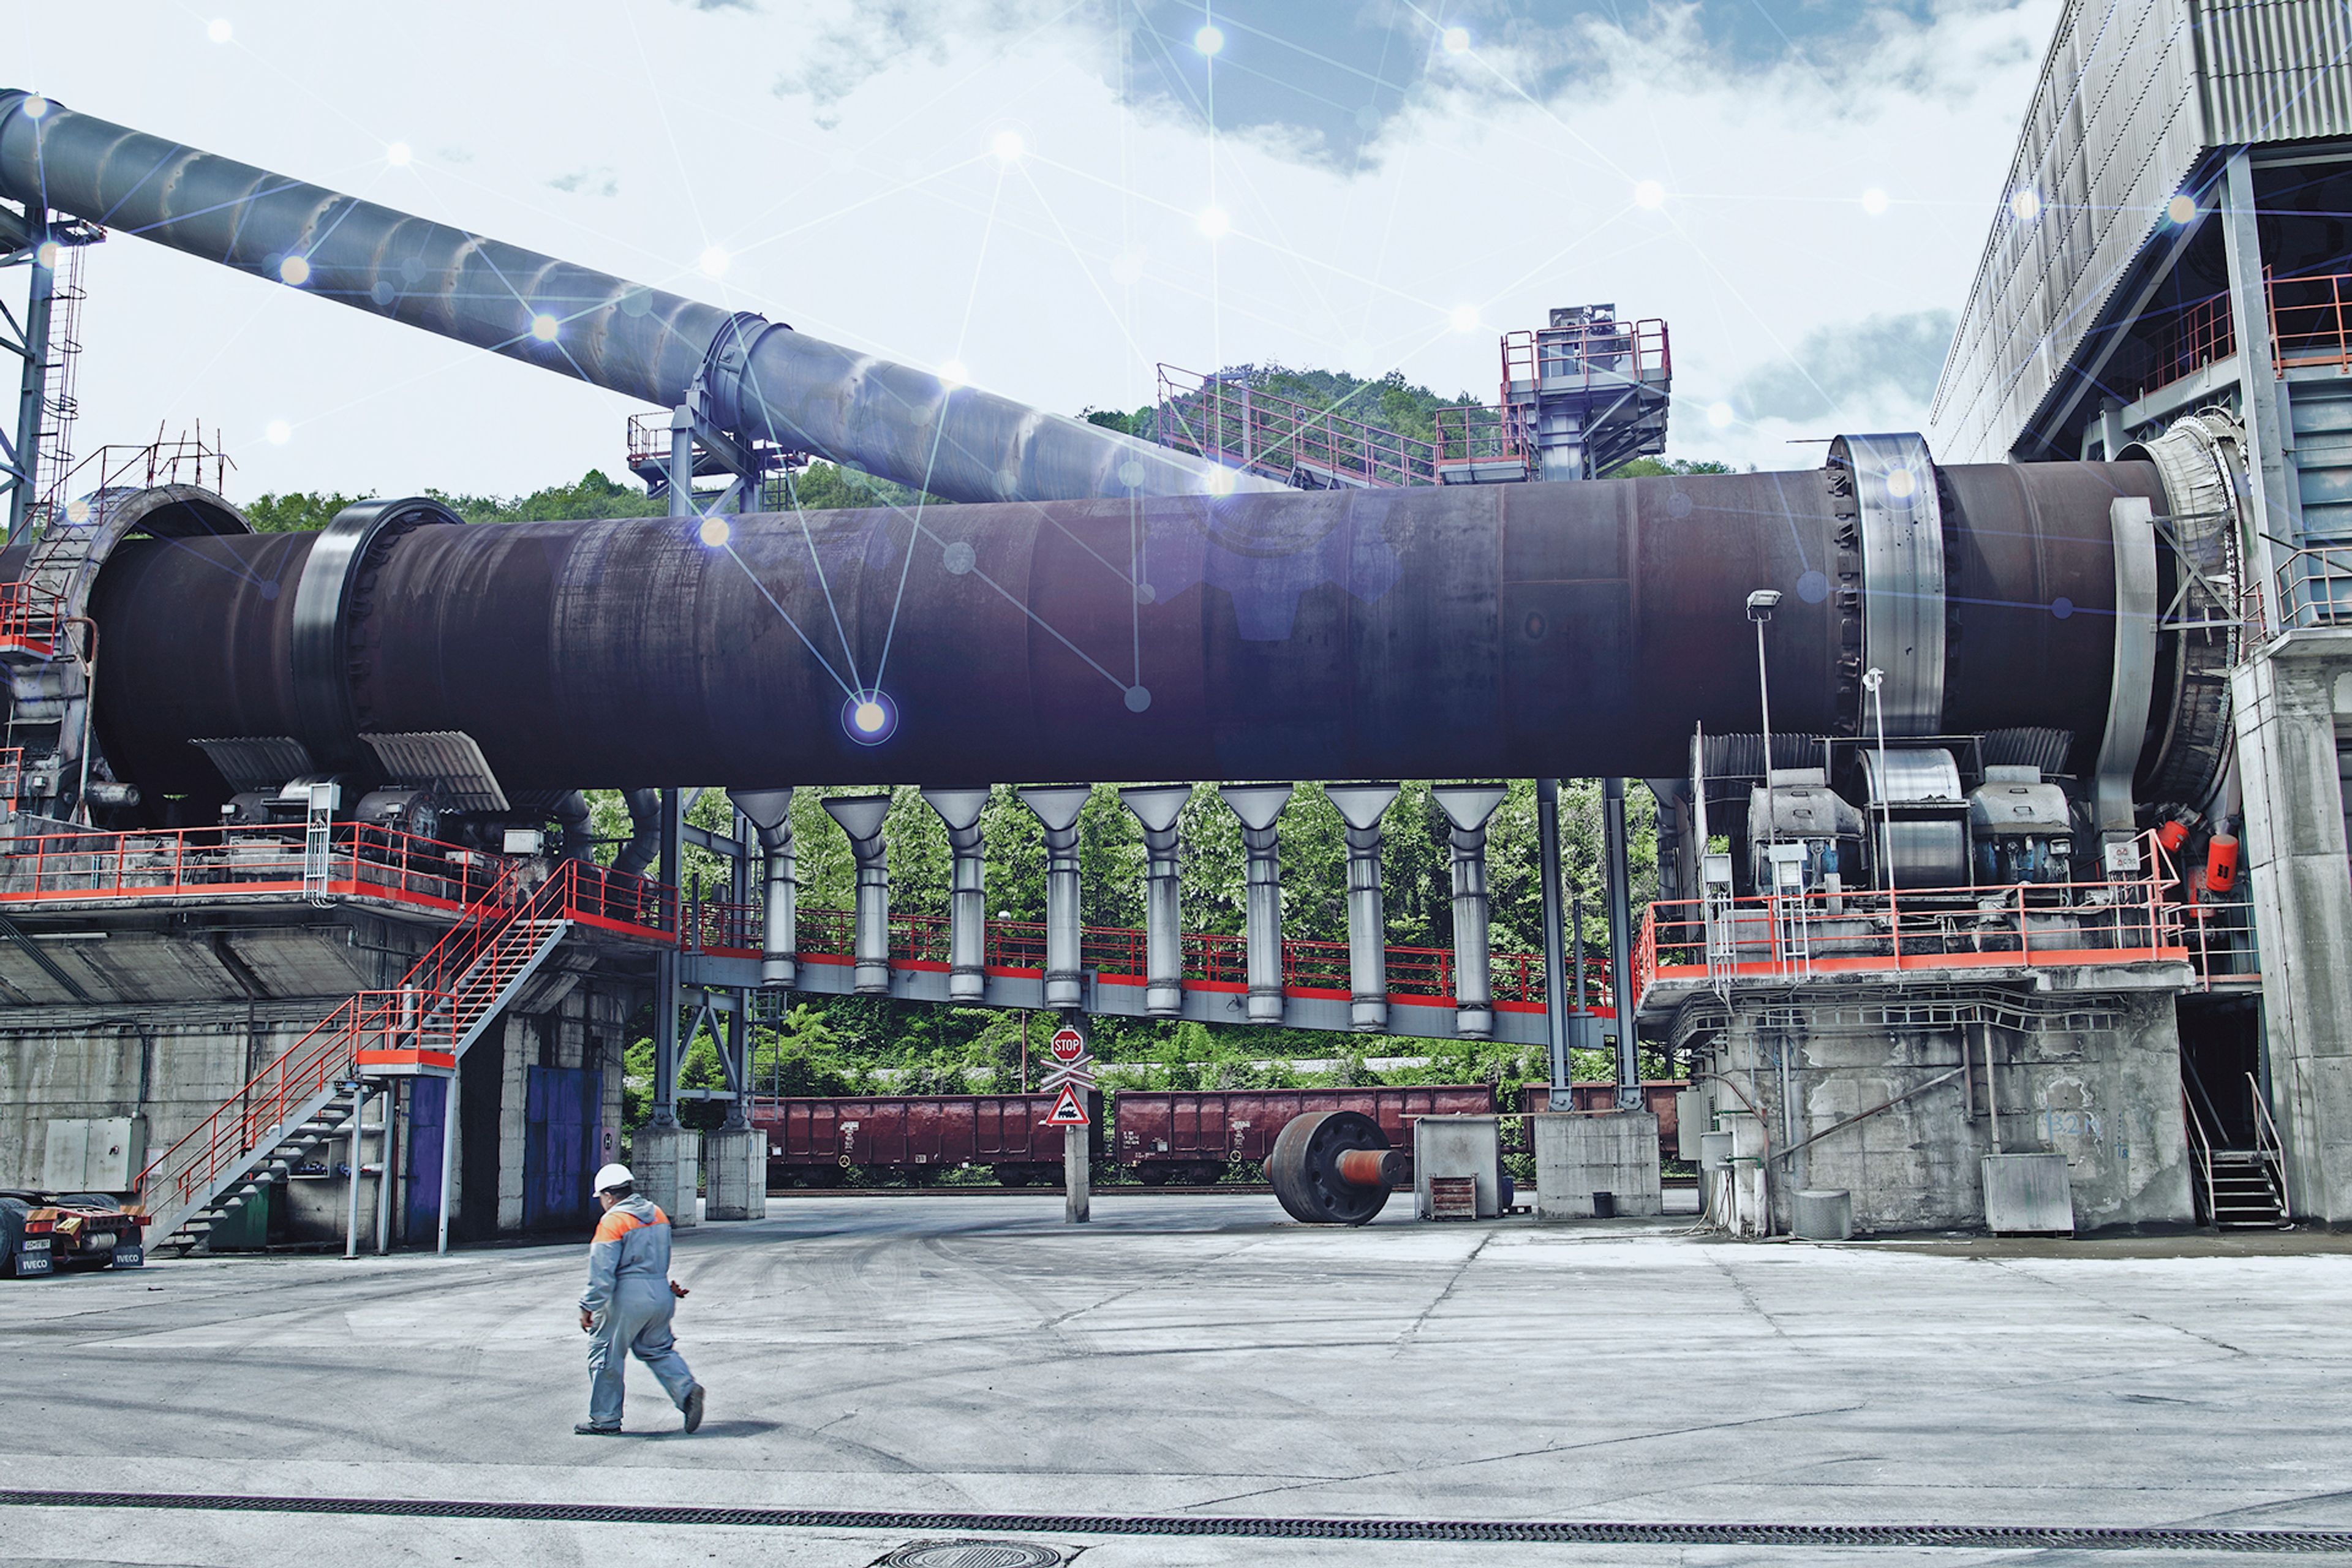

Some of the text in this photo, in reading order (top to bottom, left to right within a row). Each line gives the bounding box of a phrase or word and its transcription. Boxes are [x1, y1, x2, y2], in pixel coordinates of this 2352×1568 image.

[1055, 1039, 1079, 1052] STOP
[116, 1254, 140, 1263] IVECO
[23, 1259, 48, 1270] IVECO
